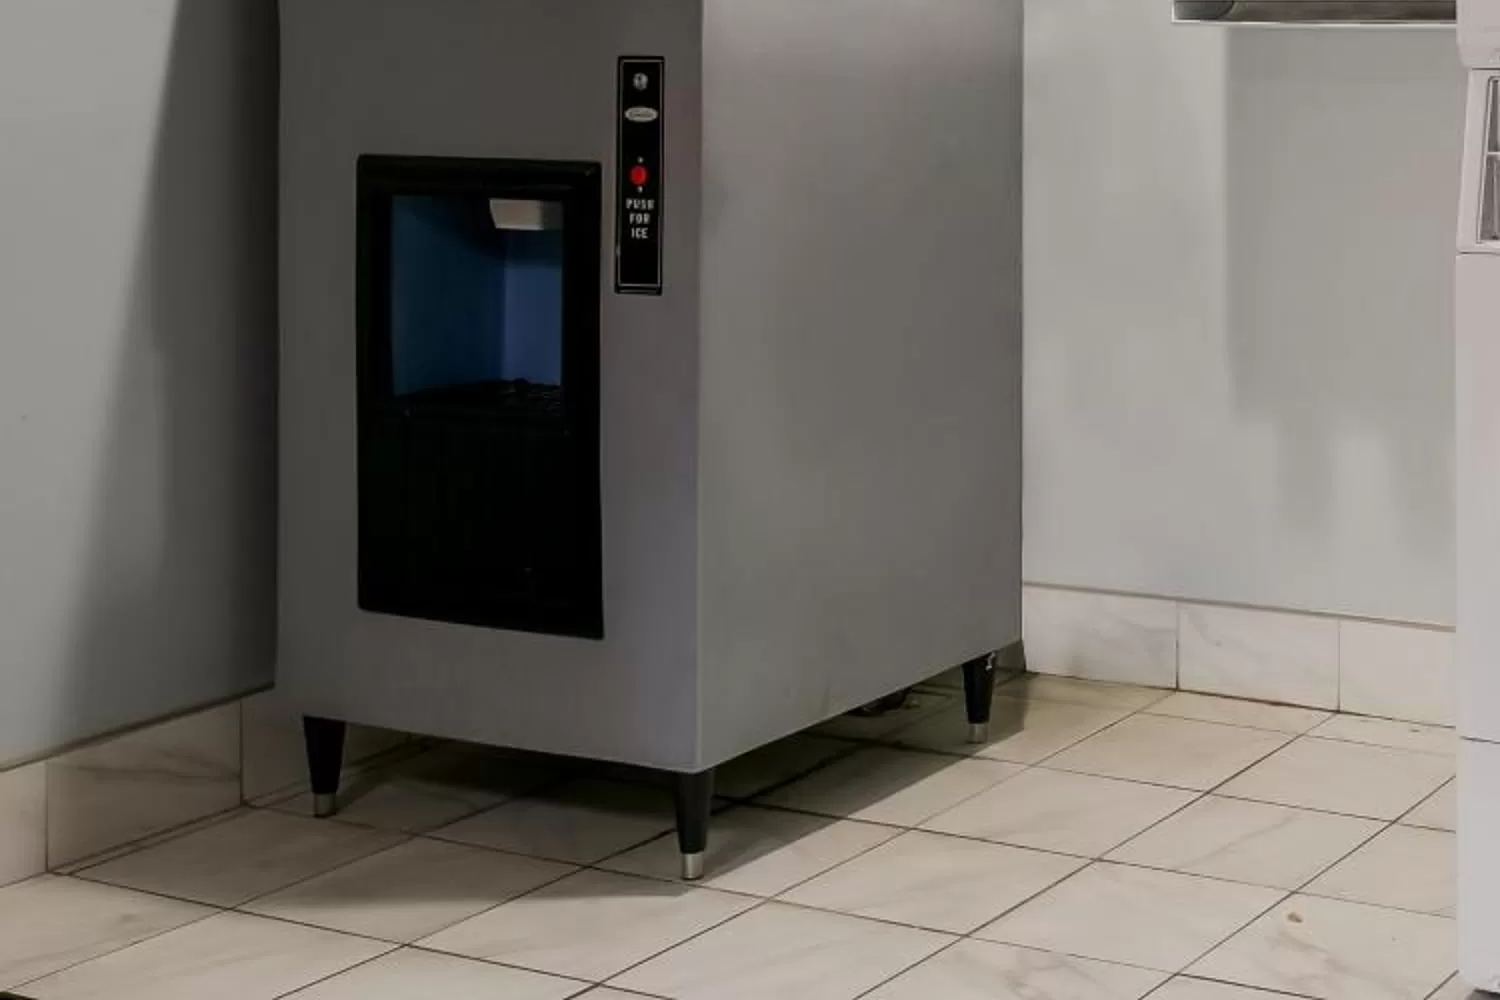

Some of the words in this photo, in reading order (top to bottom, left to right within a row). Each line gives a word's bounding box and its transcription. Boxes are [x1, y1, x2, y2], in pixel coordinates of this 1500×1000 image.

[626, 198, 655, 210] PUSH
[629, 212, 650, 225] FOR
[631, 227, 649, 239] ICE
